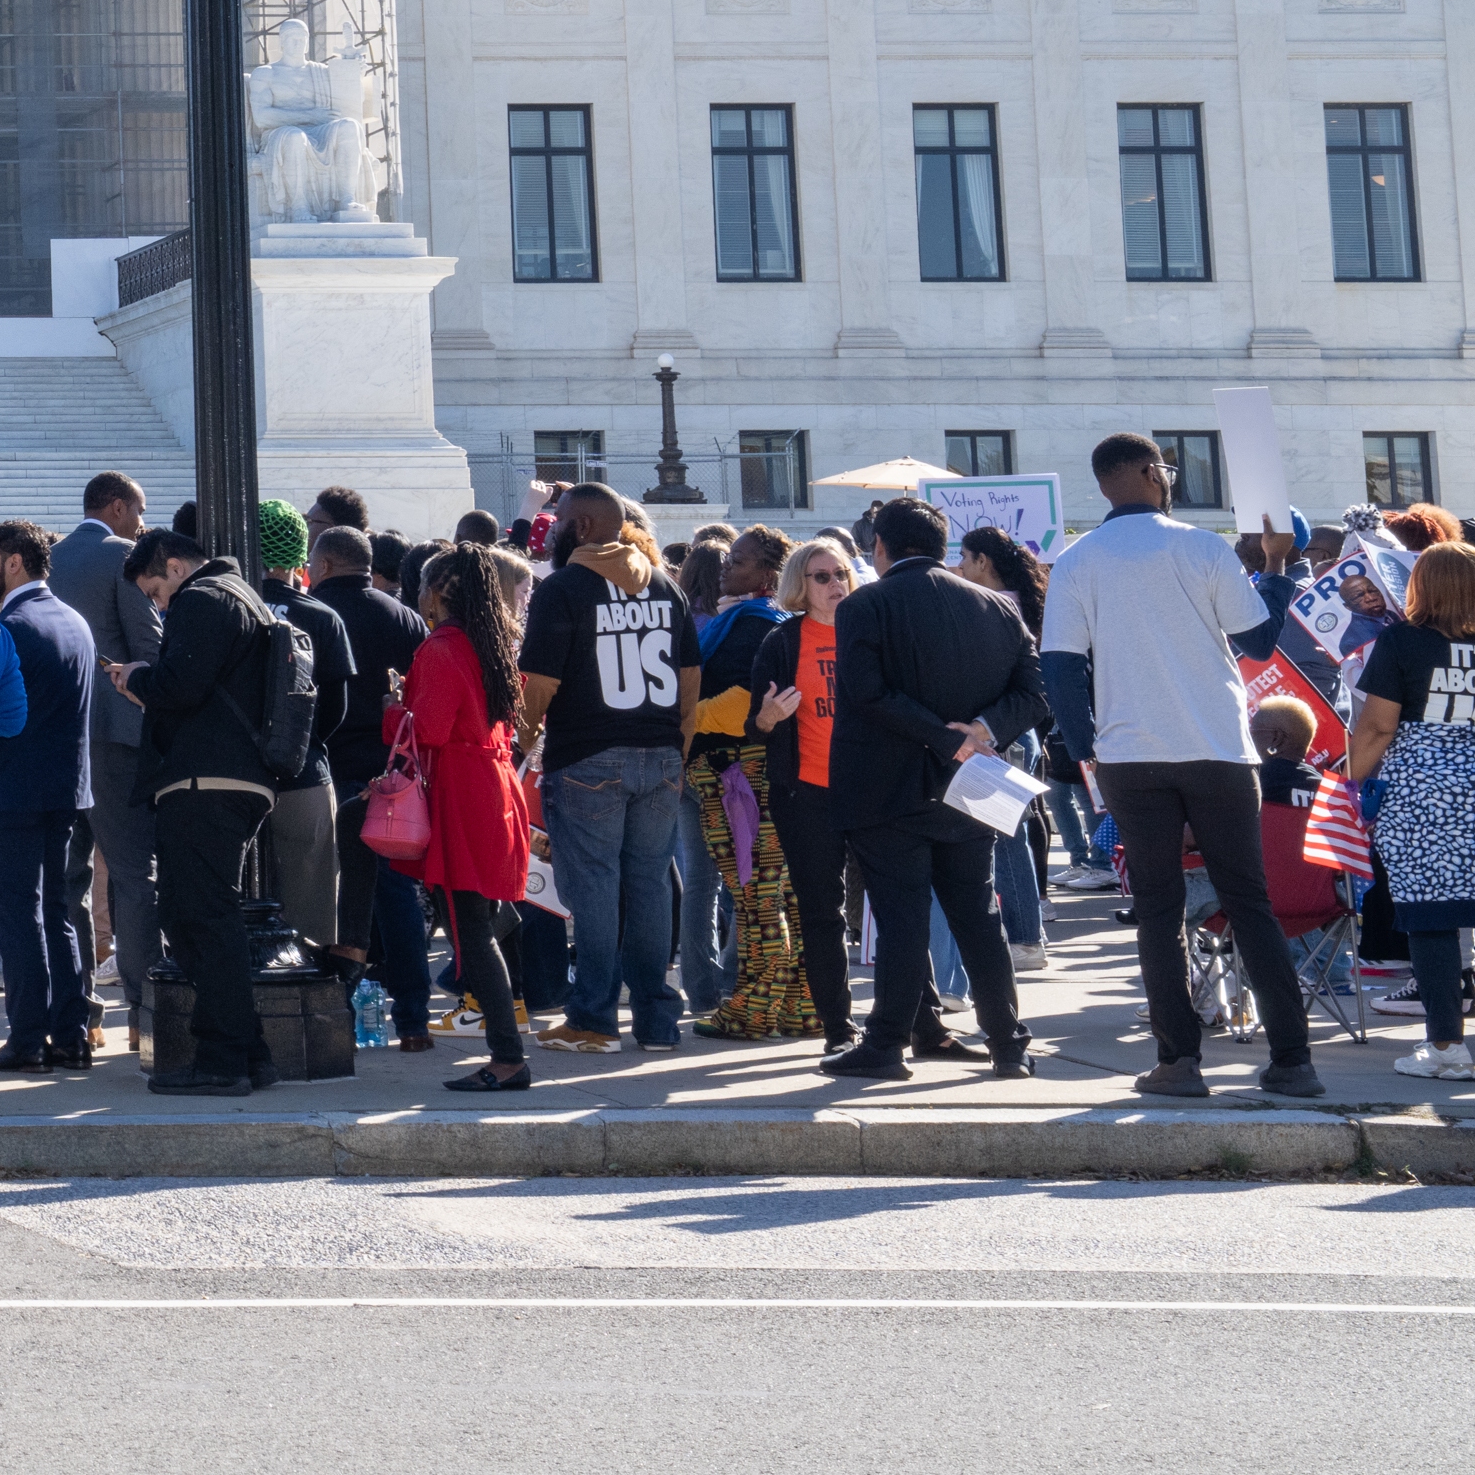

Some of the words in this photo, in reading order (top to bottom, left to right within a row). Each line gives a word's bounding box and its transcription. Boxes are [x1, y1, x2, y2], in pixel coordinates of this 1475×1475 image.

[941, 491, 984, 517] Voting
[988, 491, 1020, 512] Rights
[948, 508, 1025, 539] NOW!
[596, 600, 673, 633] ABOUT
[596, 629, 678, 710] US
[1310, 749, 1330, 766] ACLU
